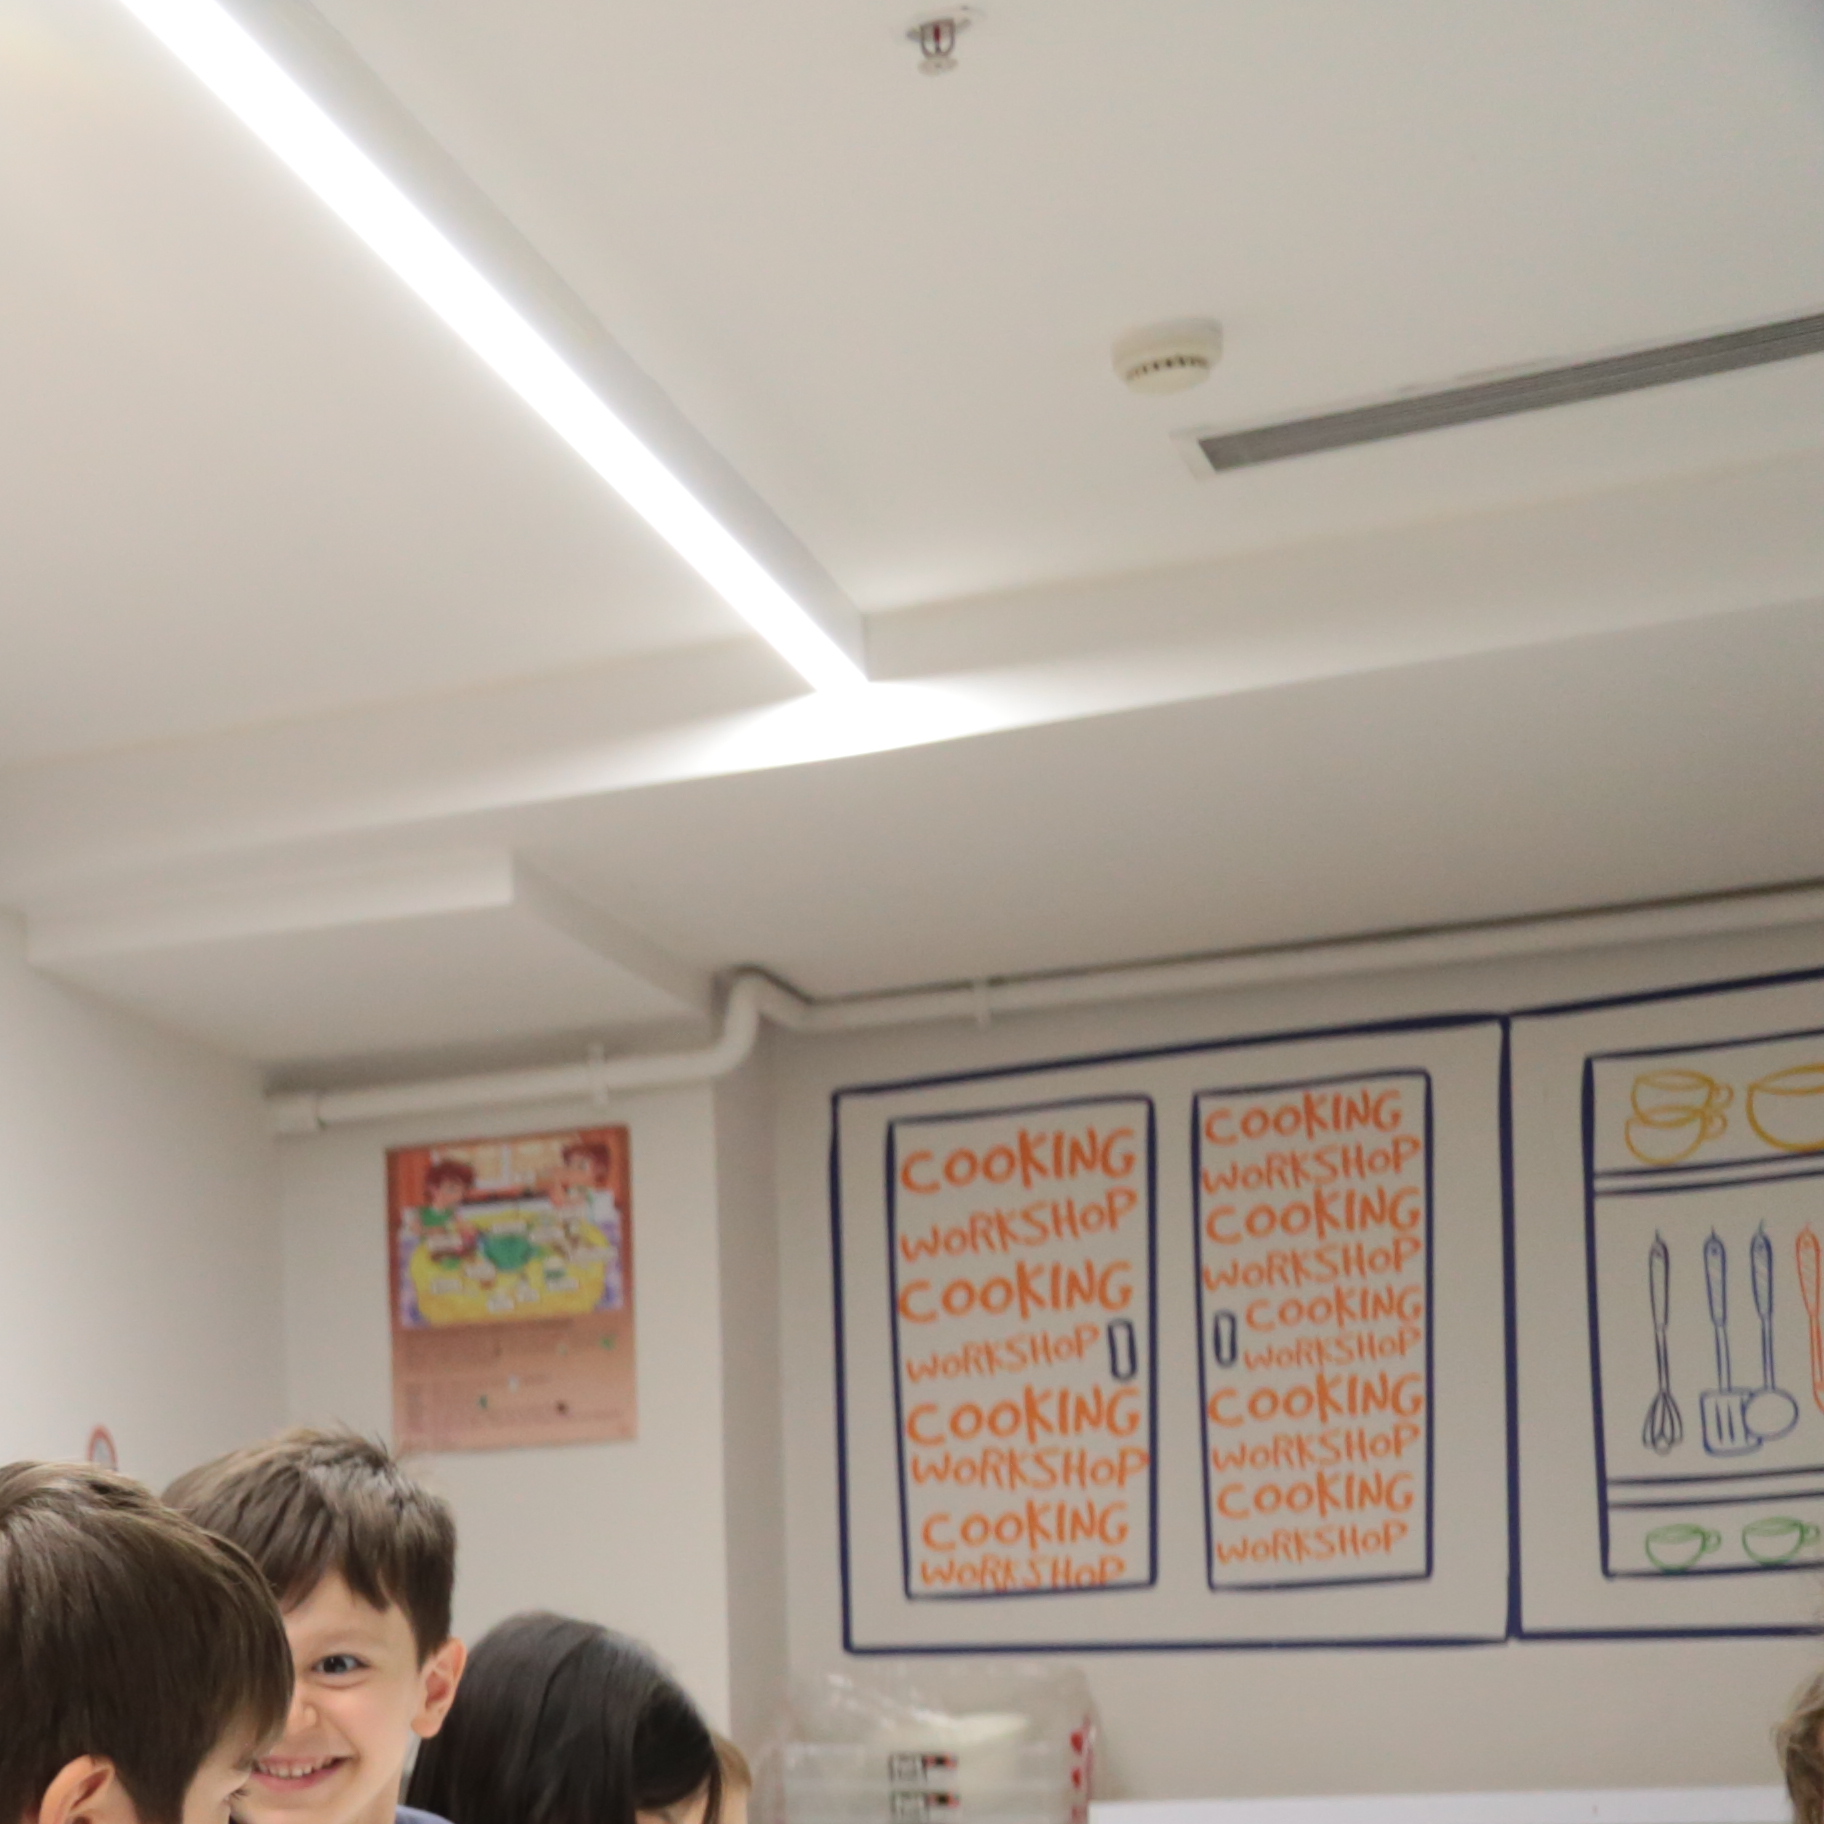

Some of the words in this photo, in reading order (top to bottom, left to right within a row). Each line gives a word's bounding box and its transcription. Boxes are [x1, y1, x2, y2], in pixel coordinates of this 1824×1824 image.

[1203, 1089, 1403, 1145] COOKING
[899, 1127, 1137, 1194] COOKING
[1201, 1135, 1423, 1195] WORKSHOP
[899, 1187, 1138, 1263] WORKSHOP
[1204, 1186, 1423, 1244] COOKING
[1201, 1235, 1424, 1291] WORKSHOP
[898, 1260, 1134, 1323] COOKING
[1245, 1284, 1423, 1333] COOKING
[905, 1323, 1101, 1383] WORKSHOP
[1242, 1326, 1424, 1372] WORKSHOP
[905, 1386, 1143, 1446] COOKING
[1206, 1371, 1425, 1427] COOKING
[910, 1448, 1151, 1491] WORKSHOP
[1211, 1423, 1422, 1473] WORKSHOP
[1216, 1470, 1416, 1520] COOKING
[921, 1499, 1129, 1552] COOKING
[1215, 1520, 1410, 1565] WORKSHOP
[920, 1555, 1126, 1590] WORKSHOP
